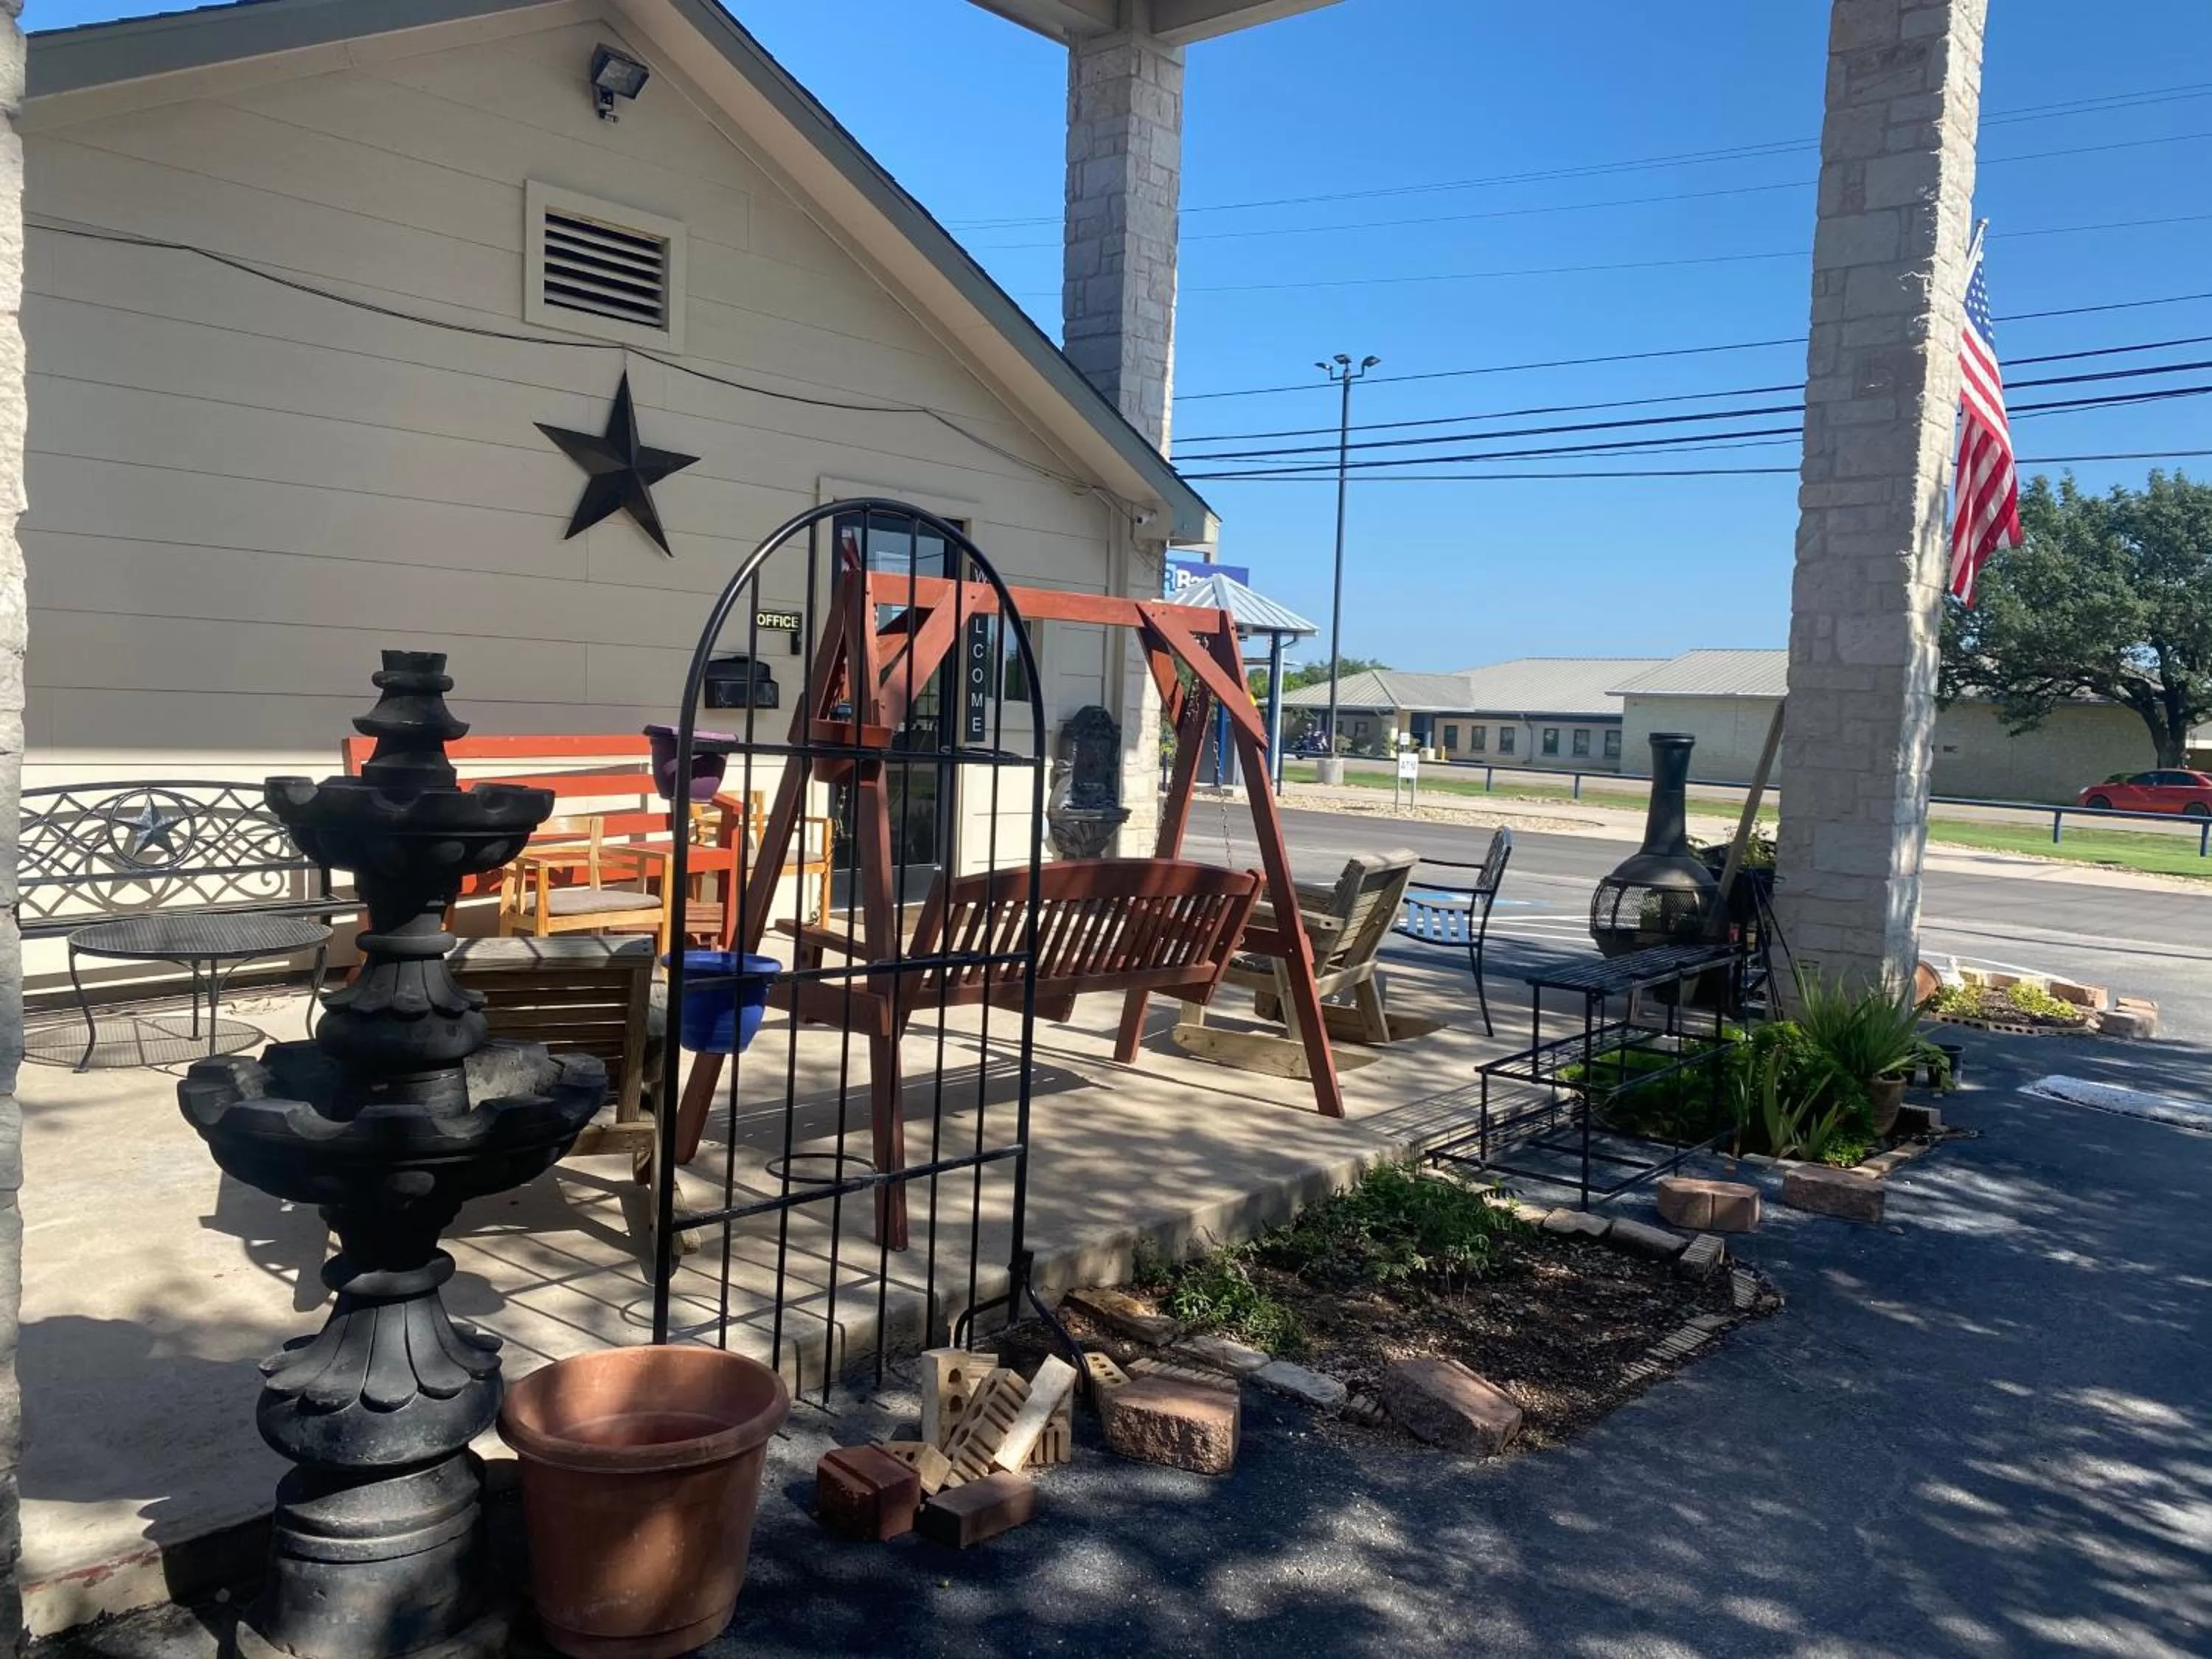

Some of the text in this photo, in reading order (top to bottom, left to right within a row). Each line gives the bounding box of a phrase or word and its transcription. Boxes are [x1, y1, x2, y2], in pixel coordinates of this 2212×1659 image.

[757, 613, 799, 627] OFFICE
[970, 567, 989, 732] WLCOME
[1400, 760, 1416, 771] ATM
